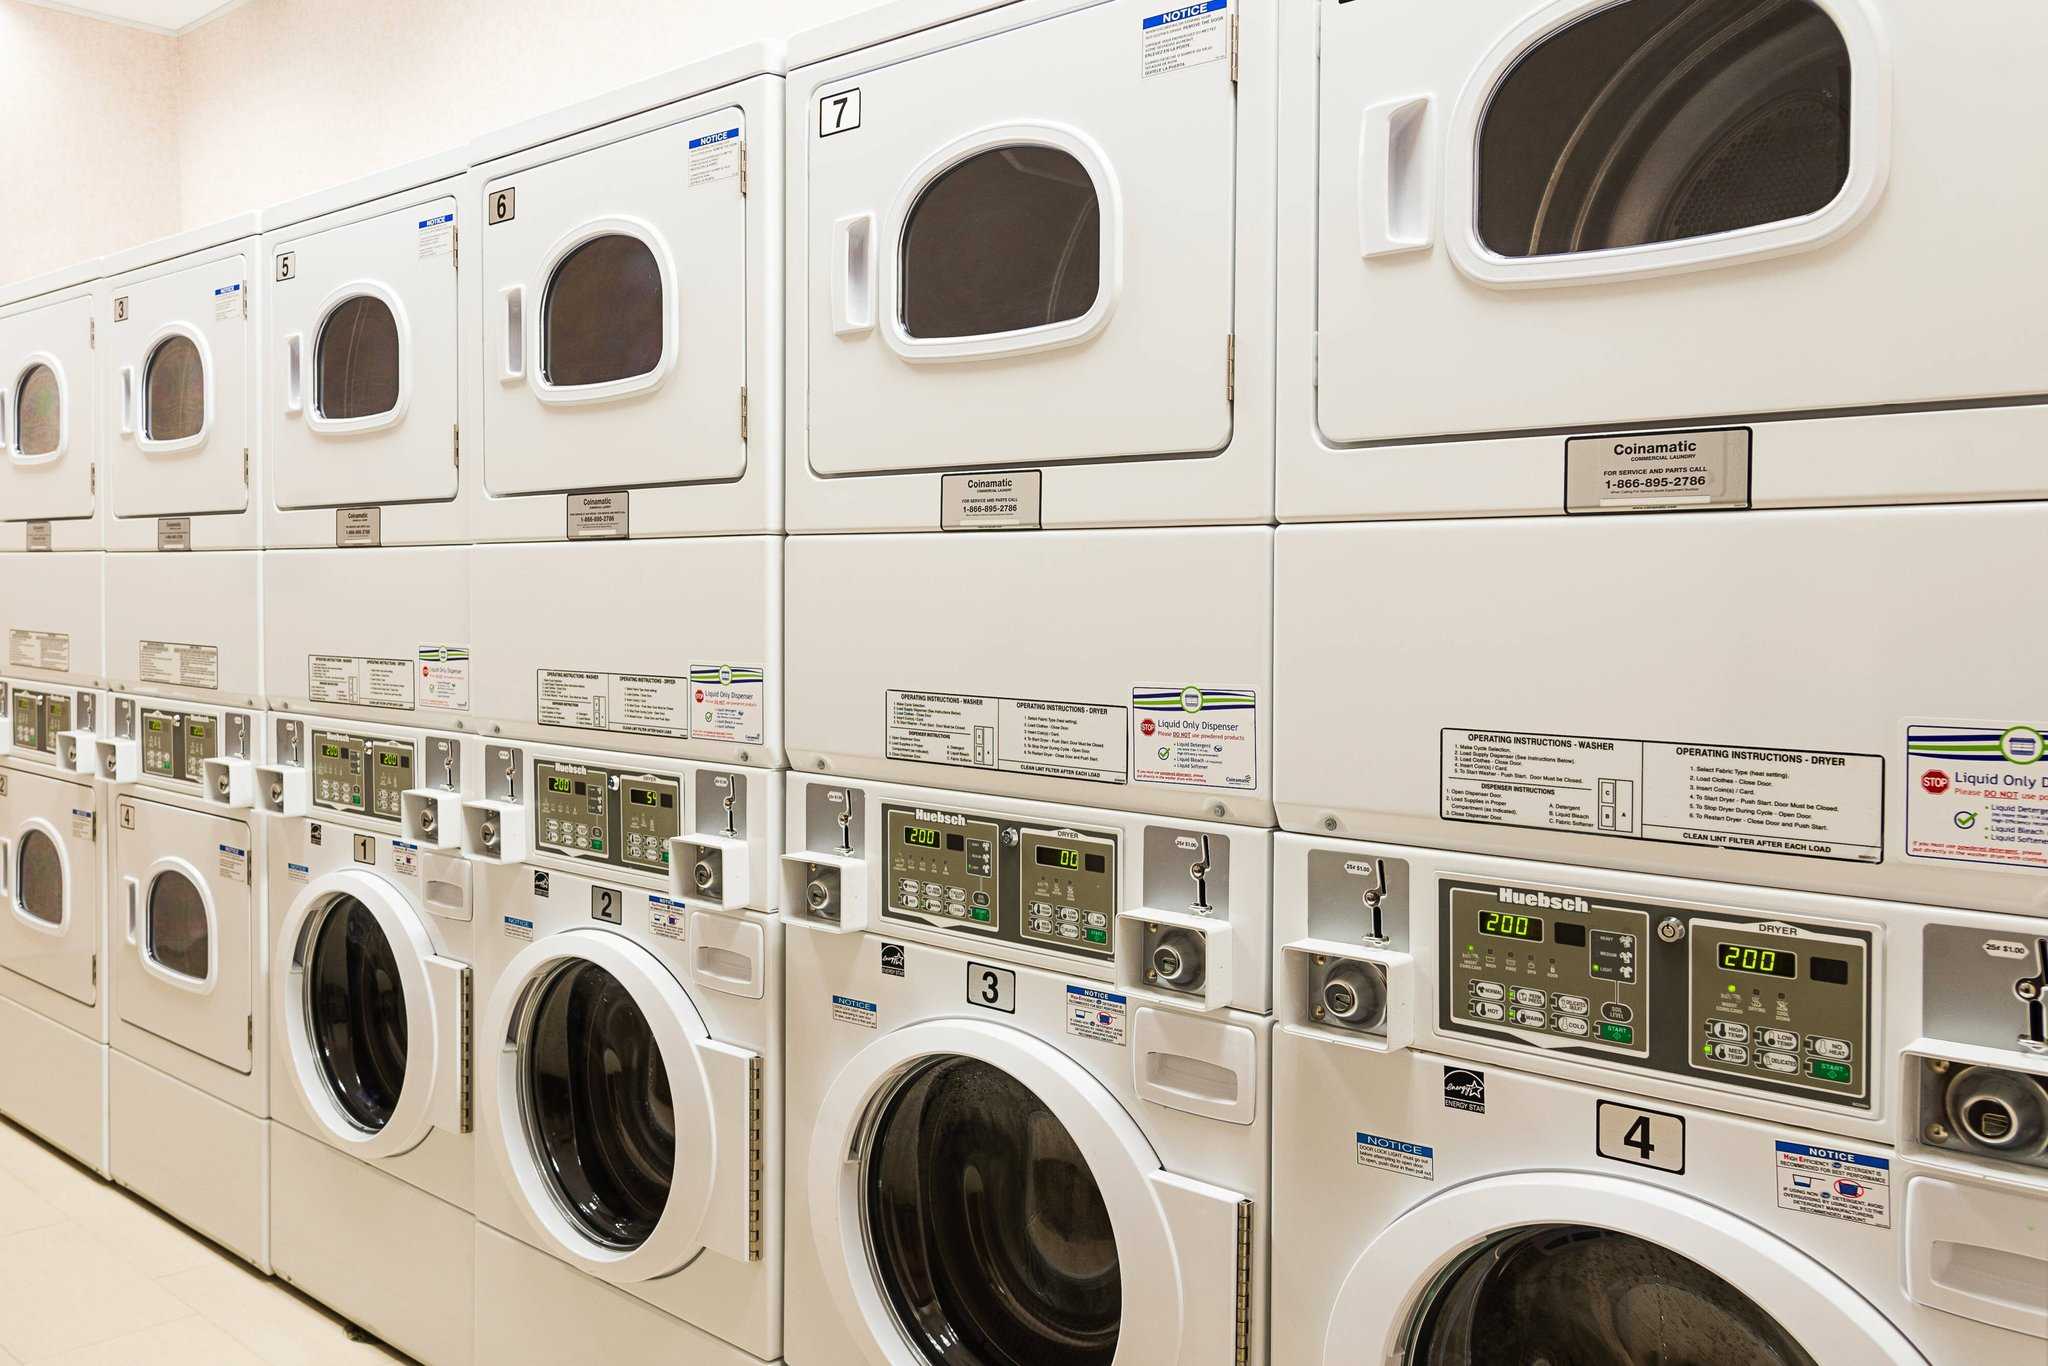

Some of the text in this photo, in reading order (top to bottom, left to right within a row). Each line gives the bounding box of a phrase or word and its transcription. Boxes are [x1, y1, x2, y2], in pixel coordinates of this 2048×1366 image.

[1163, 3, 1208, 23] NOTICE
[832, 97, 848, 128] 7
[701, 132, 727, 145] NOTICE
[496, 194, 506, 219] 6
[282, 256, 289, 277] 5
[118, 300, 125, 319] 3
[1614, 440, 1696, 455] Coinamatic
[968, 478, 1012, 488] Coinamatic
[1605, 476, 1706, 489] 1-866-895-2786
[927, 695, 959, 703] INSTRUCTIONS
[1046, 704, 1085, 713] INSTRUCTIONS
[1142, 723, 1154, 731] STOP
[1158, 720, 1238, 732] Liquid Only Dispenser
[1468, 734, 1614, 750] OPERATING INSTRUCTIONS WASHER
[327, 745, 337, 756] 200
[1676, 747, 1845, 766] OPERATING INSTRUCTIONS DRYER
[384, 753, 396, 765] 200
[555, 763, 586, 775] Huebsch
[554, 779, 568, 791] 200
[1924, 778, 1948, 787] STOP
[1955, 772, 1998, 786] Liquid
[2004, 774, 2036, 789] Only
[1514, 786, 1555, 794] INSTRUCTIONS
[124, 809, 131, 826] 4
[915, 809, 965, 826] Huebsch
[1736, 808, 1755, 816] During
[911, 829, 934, 844] 200
[1683, 833, 1708, 841] CLEAN
[1729, 837, 1754, 845] FILTER
[1757, 840, 1783, 848] AFTER
[1785, 842, 1807, 850] EACH
[1808, 845, 1831, 853] LOAD
[361, 840, 366, 860] 1
[1061, 851, 1078, 867] 00
[601, 892, 612, 918] 2
[1500, 888, 1588, 913] Huebsch
[1487, 913, 1528, 936] 200
[1759, 924, 1798, 936] DRYER
[2003, 945, 2024, 954] $1.00
[1725, 947, 1775, 971] 200
[982, 971, 998, 1003] 3
[1485, 987, 1502, 996] NORMAL
[1085, 990, 1108, 999] NOTICE
[839, 998, 870, 1009] NOTICE
[1771, 1057, 1796, 1066] DELICATES
[1822, 1063, 1843, 1072] START
[1446, 1100, 1485, 1112] ENERGY STAR
[1624, 1116, 1654, 1160] 4
[1367, 1136, 1423, 1155] NOTICE
[1809, 1148, 1855, 1162] NOTICE
